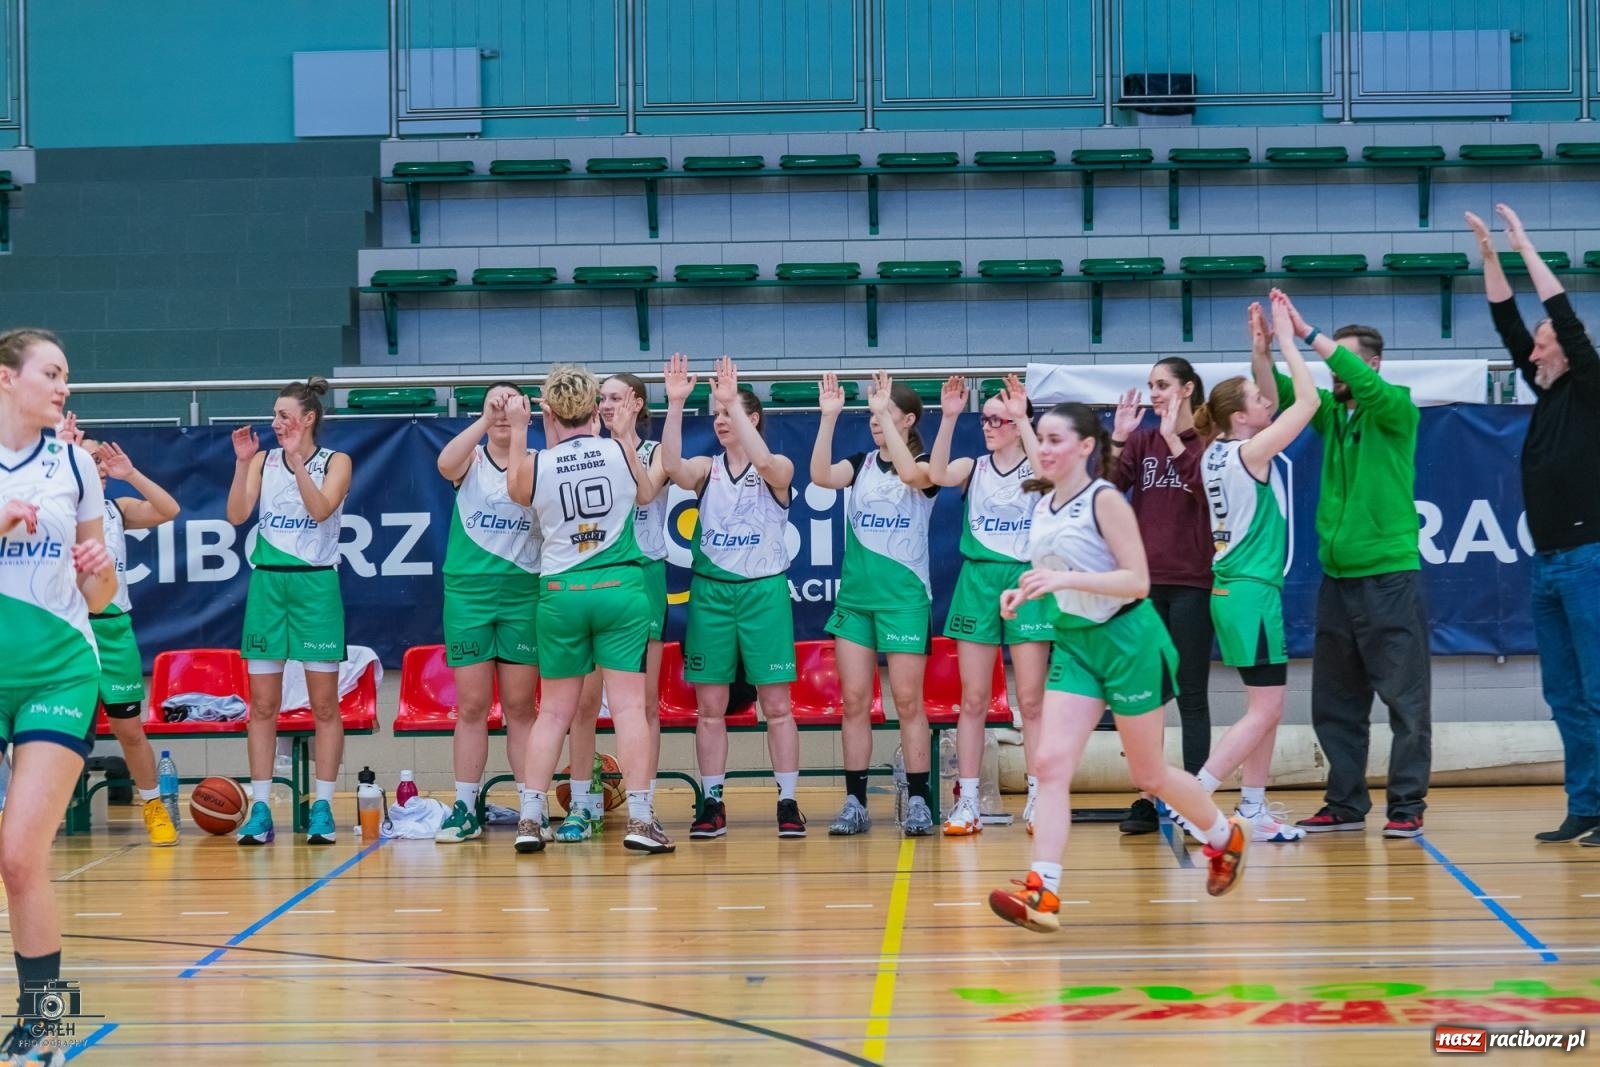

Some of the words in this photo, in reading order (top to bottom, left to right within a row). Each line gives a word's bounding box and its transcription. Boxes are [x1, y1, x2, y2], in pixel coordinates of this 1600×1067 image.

[556, 453, 578, 464] RKK
[583, 450, 602, 460] AZS
[41, 459, 61, 479] 7
[556, 459, 606, 474] RACIBÓRZ
[558, 475, 614, 523] 10
[269, 514, 319, 530] Clavis
[479, 513, 532, 532] Clavis
[861, 513, 911, 529] Clavis
[712, 532, 761, 547] Clavis
[949, 613, 978, 636] 85
[451, 640, 480, 661] 24
